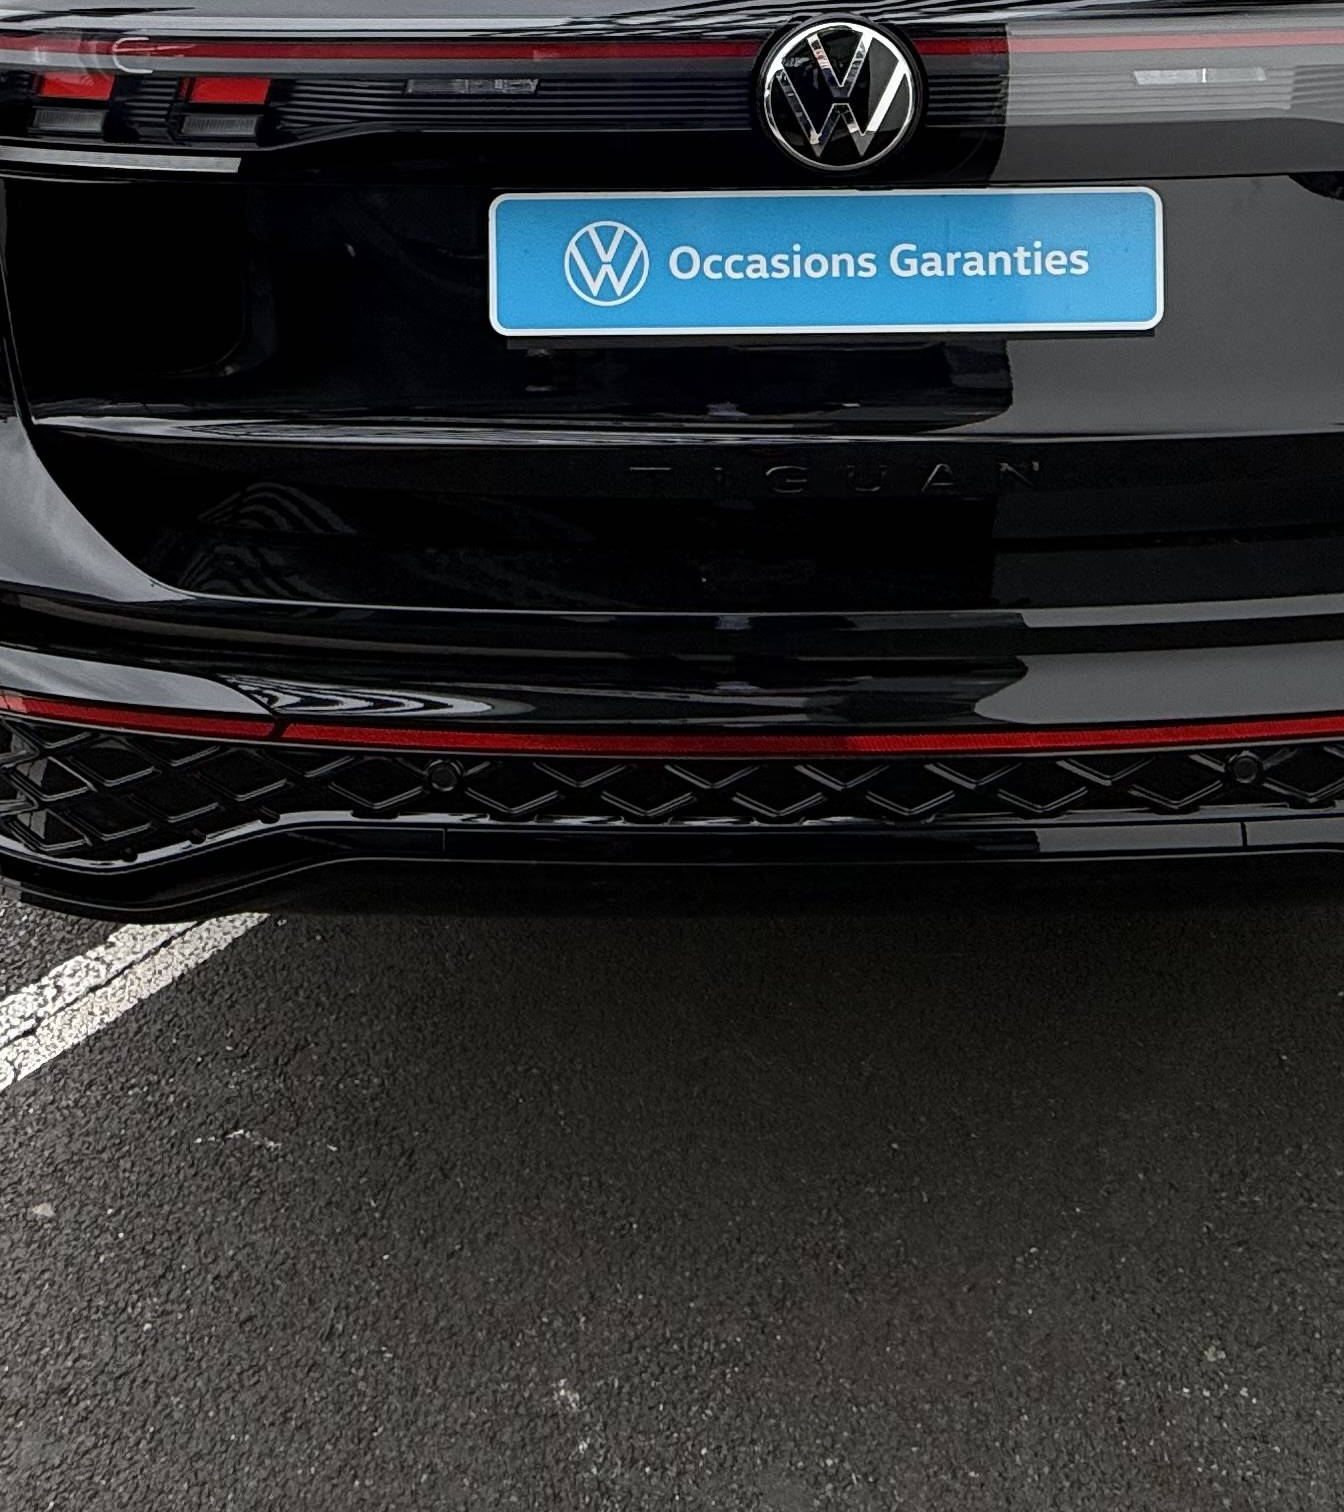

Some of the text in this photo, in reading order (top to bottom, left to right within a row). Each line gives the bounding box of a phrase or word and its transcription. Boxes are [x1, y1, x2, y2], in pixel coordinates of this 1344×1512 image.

[764, 22, 913, 172] VW
[564, 221, 1089, 307] VW Occasions Garanties
[629, 462, 1042, 493] TIGUAN
